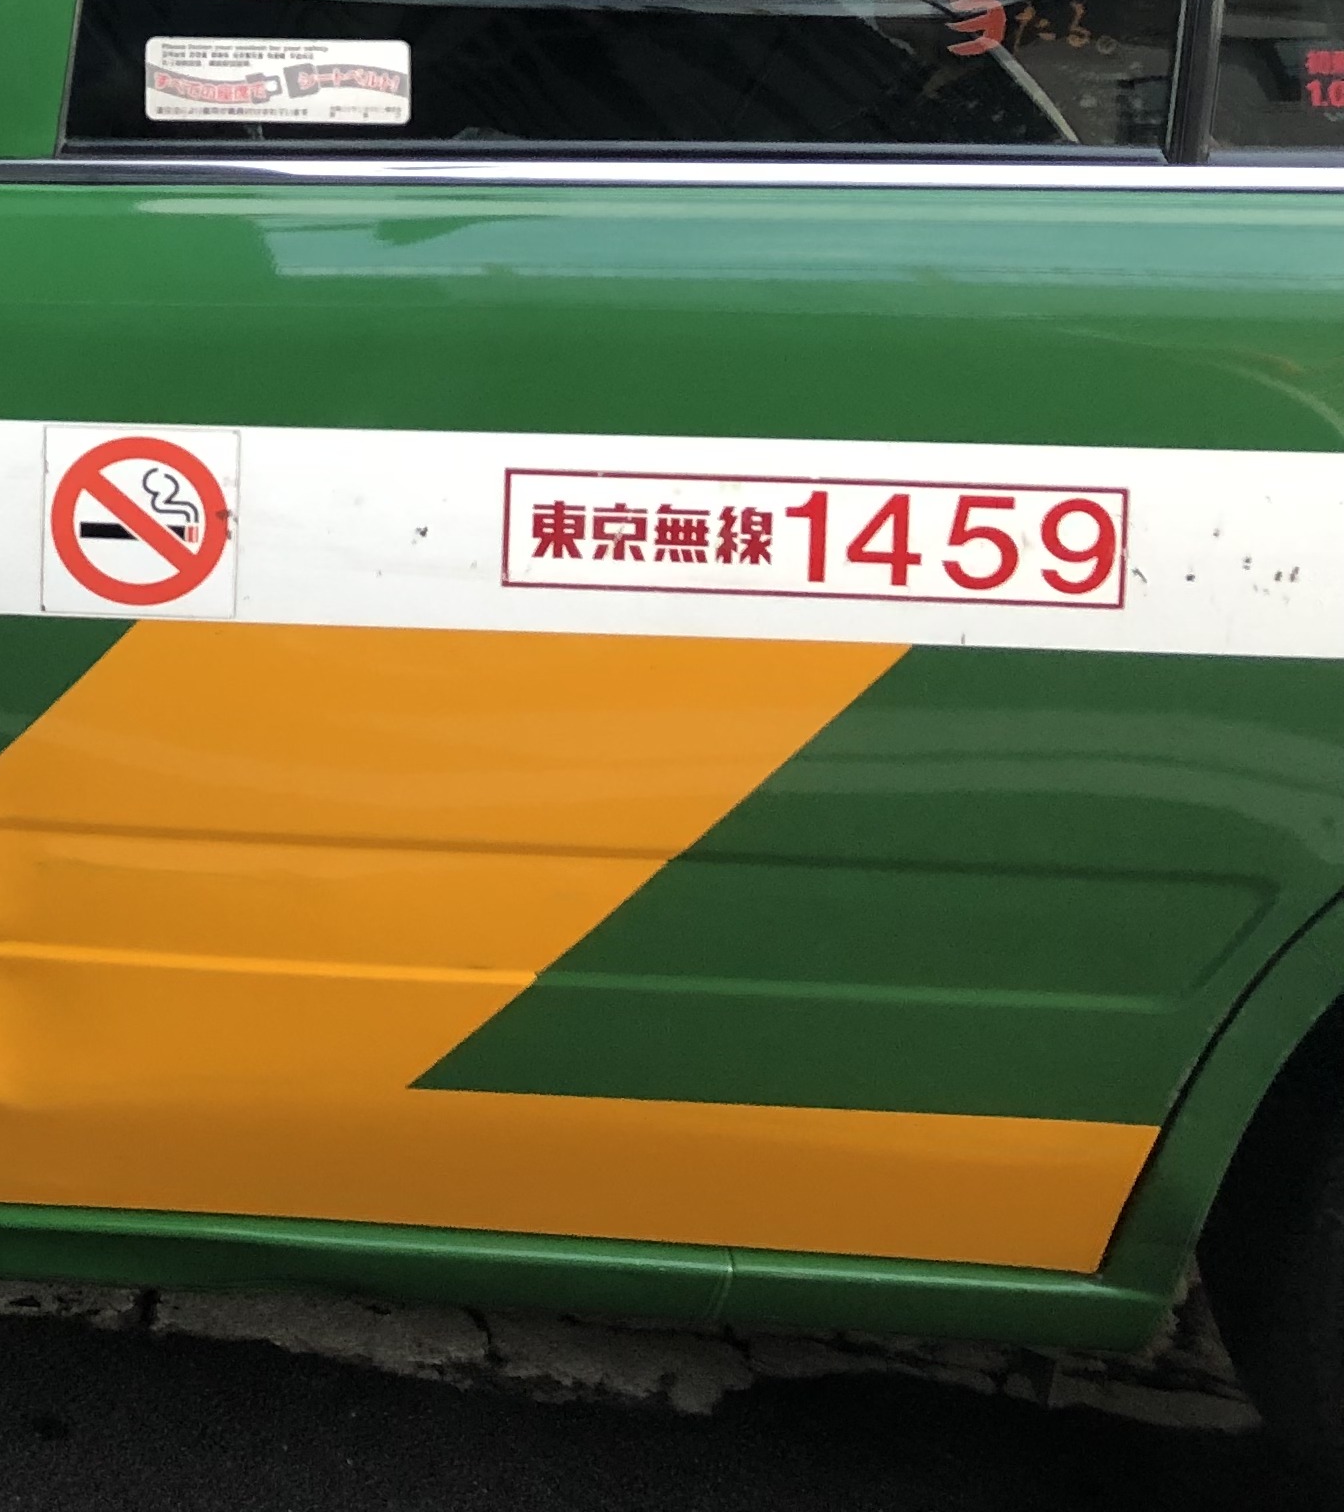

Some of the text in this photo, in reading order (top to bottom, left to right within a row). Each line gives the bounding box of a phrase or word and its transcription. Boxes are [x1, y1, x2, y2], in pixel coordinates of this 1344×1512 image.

[531, 489, 1118, 596] 東京無線 1459
